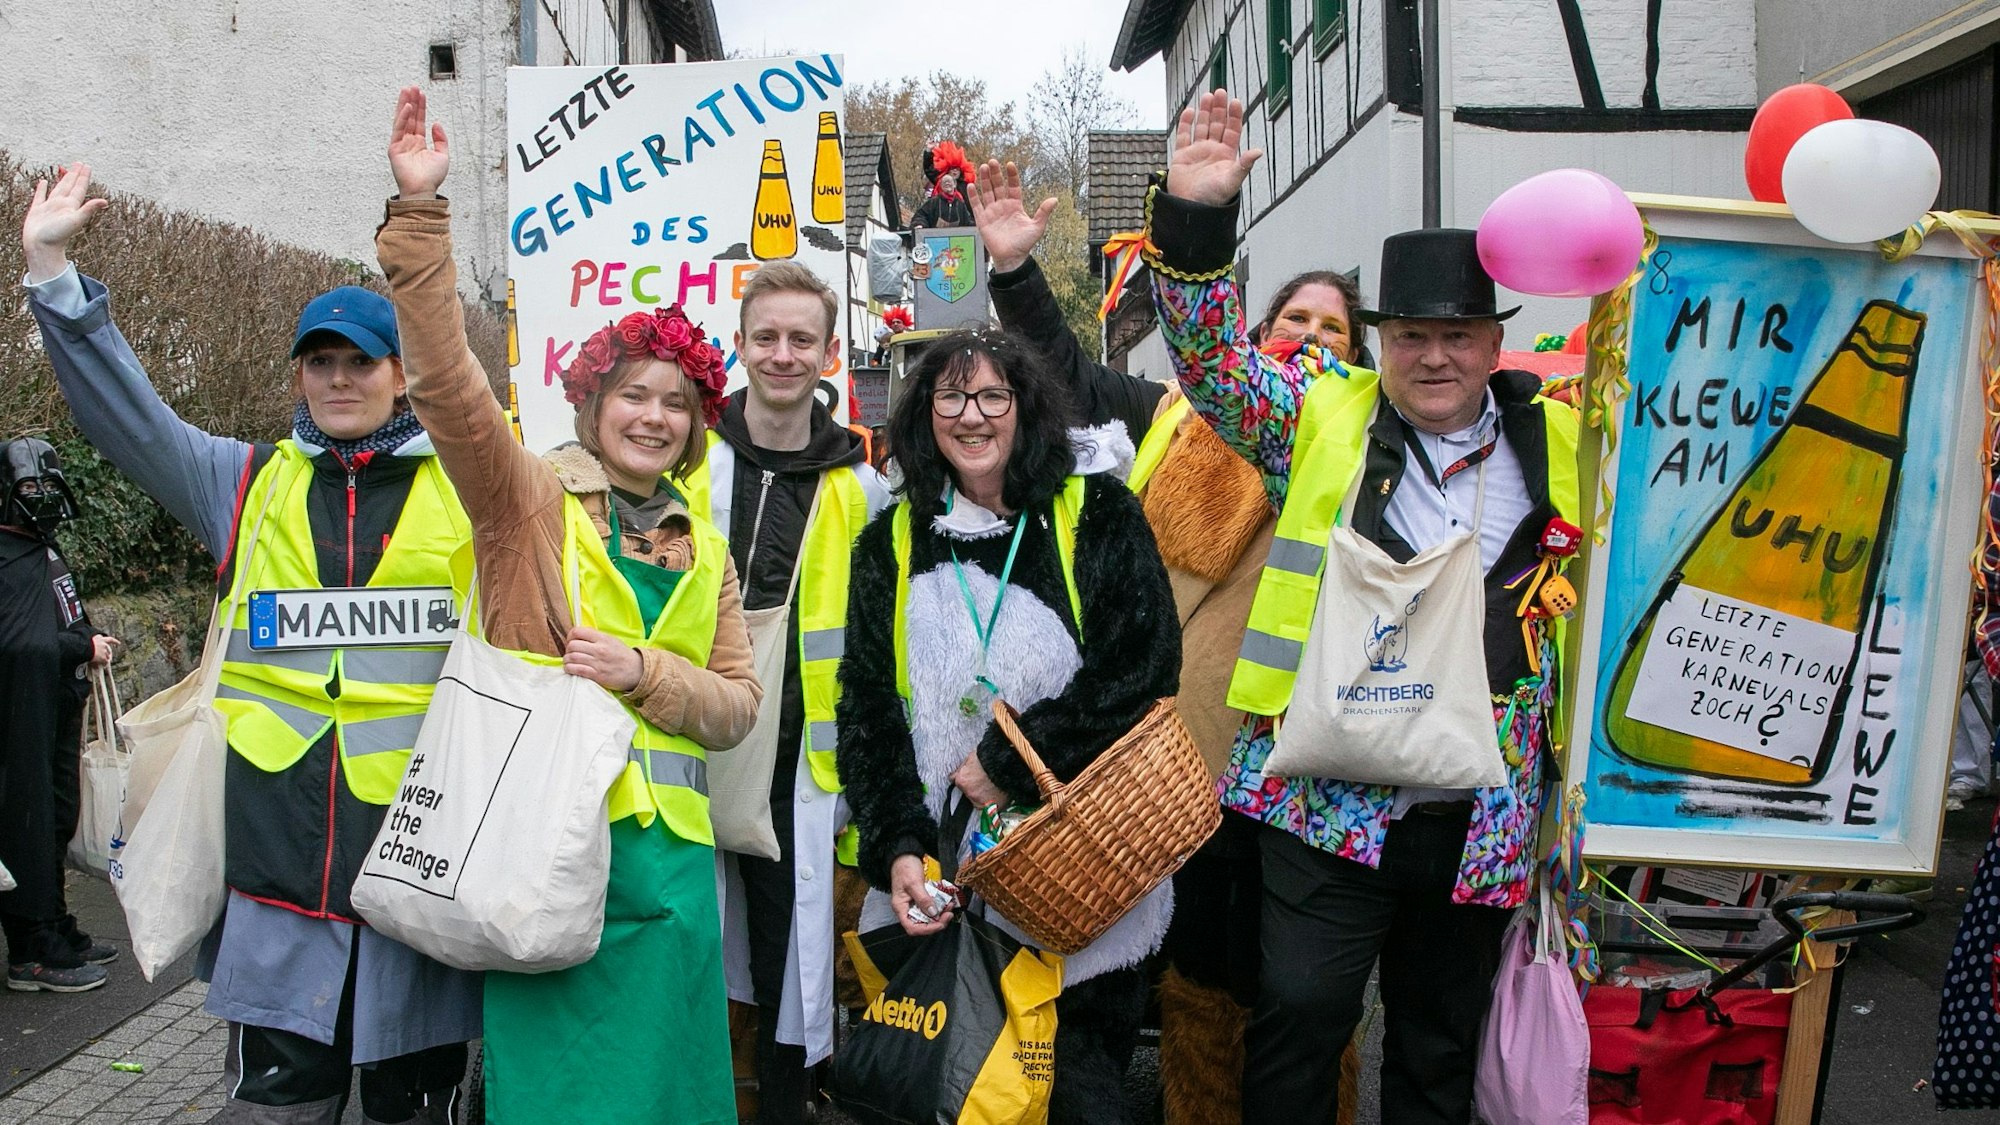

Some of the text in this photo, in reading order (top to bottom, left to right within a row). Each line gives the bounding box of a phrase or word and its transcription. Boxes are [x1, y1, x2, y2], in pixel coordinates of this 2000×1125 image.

[516, 66, 635, 173] LETZTE
[511, 54, 843, 257] GENERATION
[817, 185, 842, 195] UHU
[631, 215, 708, 246] DES
[758, 212, 792, 228] UHU
[570, 261, 762, 306] PECHE
[1649, 250, 1674, 295] 8.
[1665, 296, 1794, 353] MIR
[857, 376, 888, 387] JETZ
[858, 401, 888, 410] Somme
[1634, 378, 1791, 429] KLEWE
[1650, 438, 1729, 487] AM
[1730, 496, 1868, 573] UHU
[259, 599, 420, 639] D MANNI
[1701, 598, 1787, 638] LETZTE
[1666, 626, 1844, 685] GENERATION
[1336, 684, 1434, 702] WACHTBERG
[1681, 657, 1828, 715] KARNEVALS
[1343, 706, 1422, 715] DRACHENSTARK
[401, 784, 443, 811] wear
[390, 806, 422, 836] the
[379, 834, 449, 880] change
[863, 992, 925, 1032] Netto
[1018, 1040, 1052, 1050] HIS BAG
[1024, 1062, 1055, 1071] RECYC
